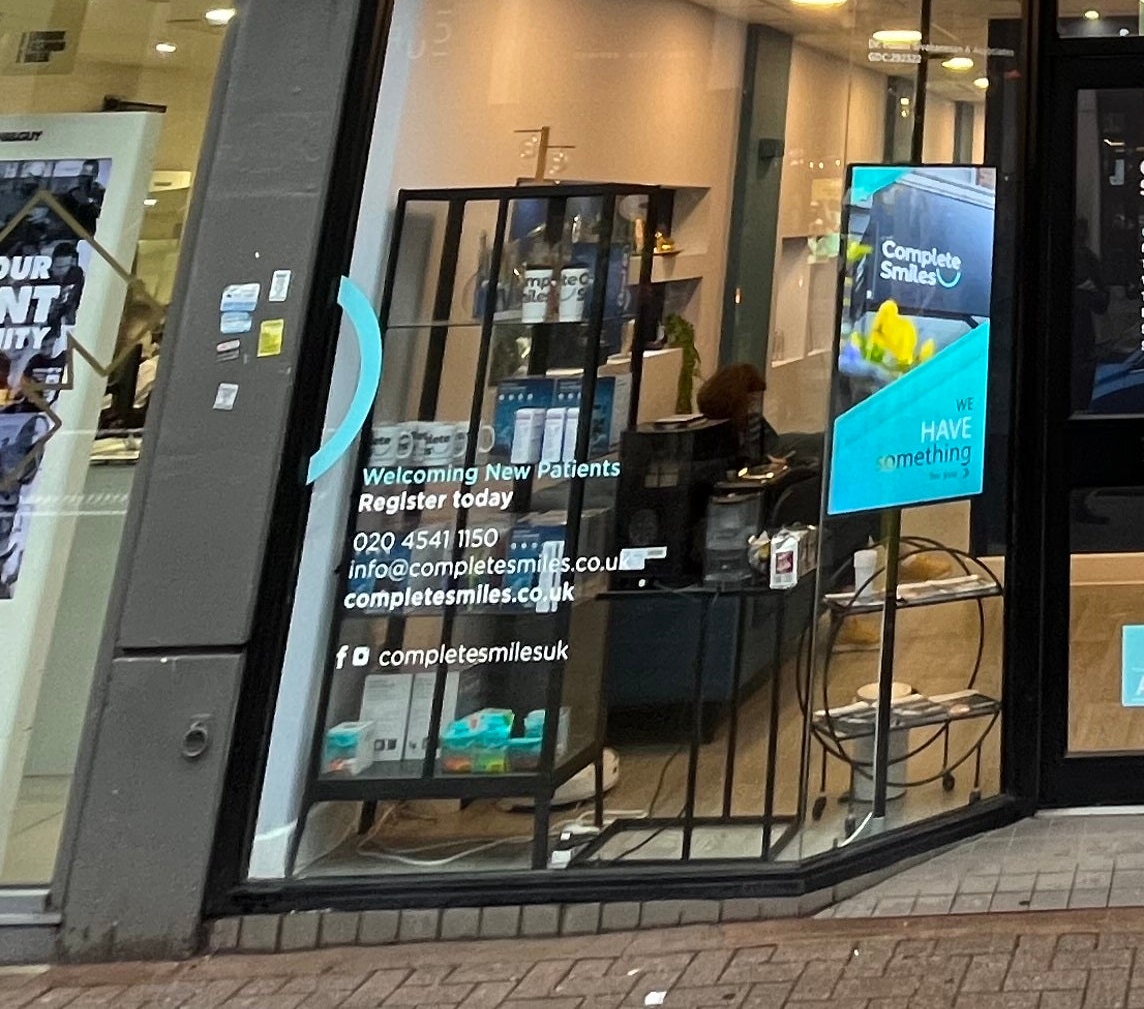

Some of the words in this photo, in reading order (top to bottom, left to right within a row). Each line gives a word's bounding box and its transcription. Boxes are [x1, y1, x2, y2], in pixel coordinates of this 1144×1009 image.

[881, 240, 962, 270] Complete
[880, 260, 938, 286] Smiles
[956, 397, 975, 411] WE
[921, 416, 972, 444] HAVE
[876, 443, 971, 469] something
[363, 465, 479, 486] Welcoming
[485, 463, 532, 481] New
[538, 460, 622, 479] Patients
[358, 490, 447, 515] Register
[453, 488, 514, 511] today
[353, 532, 395, 552] 020
[401, 530, 450, 550] 4541
[457, 528, 499, 549] 1150
[348, 550, 630, 582] info@completesmiles.co.uk
[343, 581, 575, 612] completesmiles.co.uk
[378, 639, 570, 669] completesmilesuk
